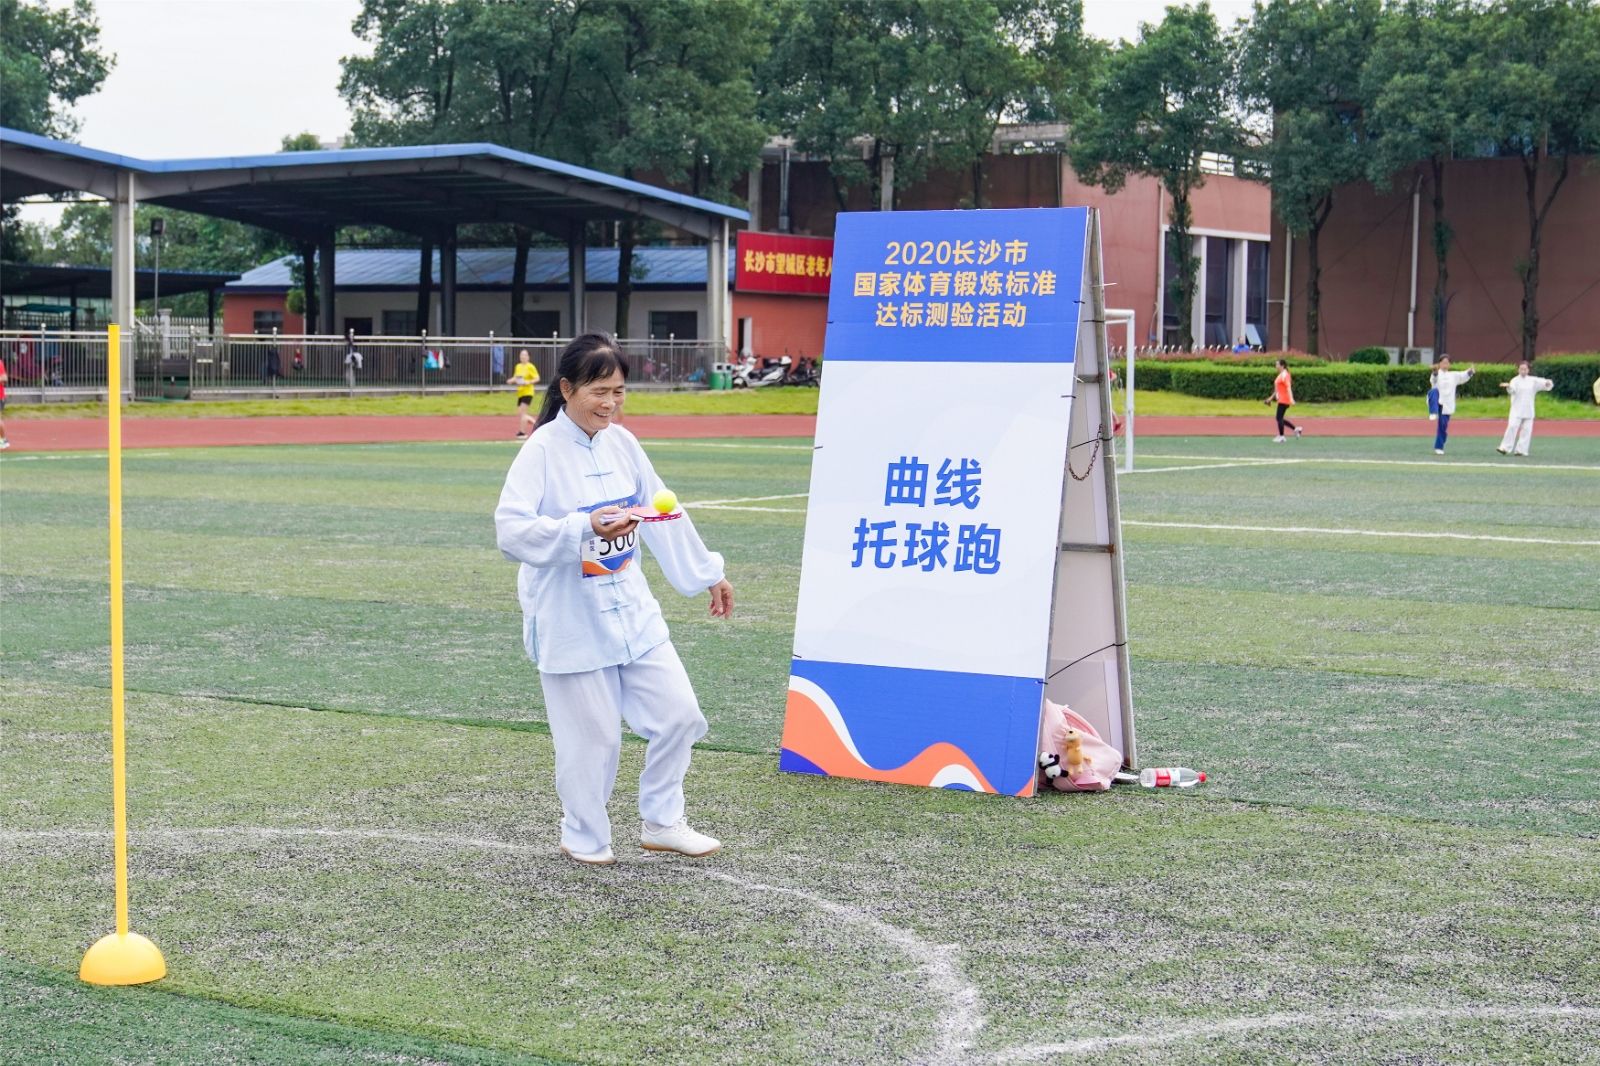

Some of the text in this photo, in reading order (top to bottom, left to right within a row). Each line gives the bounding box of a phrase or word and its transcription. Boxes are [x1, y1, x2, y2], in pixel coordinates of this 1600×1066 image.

[885, 239, 1028, 266] 2020长沙市
[853, 270, 1057, 297] 国家体育锻炼标准
[875, 301, 1027, 328] 达标测验活动
[884, 456, 982, 509] 曲线
[851, 518, 1002, 575] 托球跑
